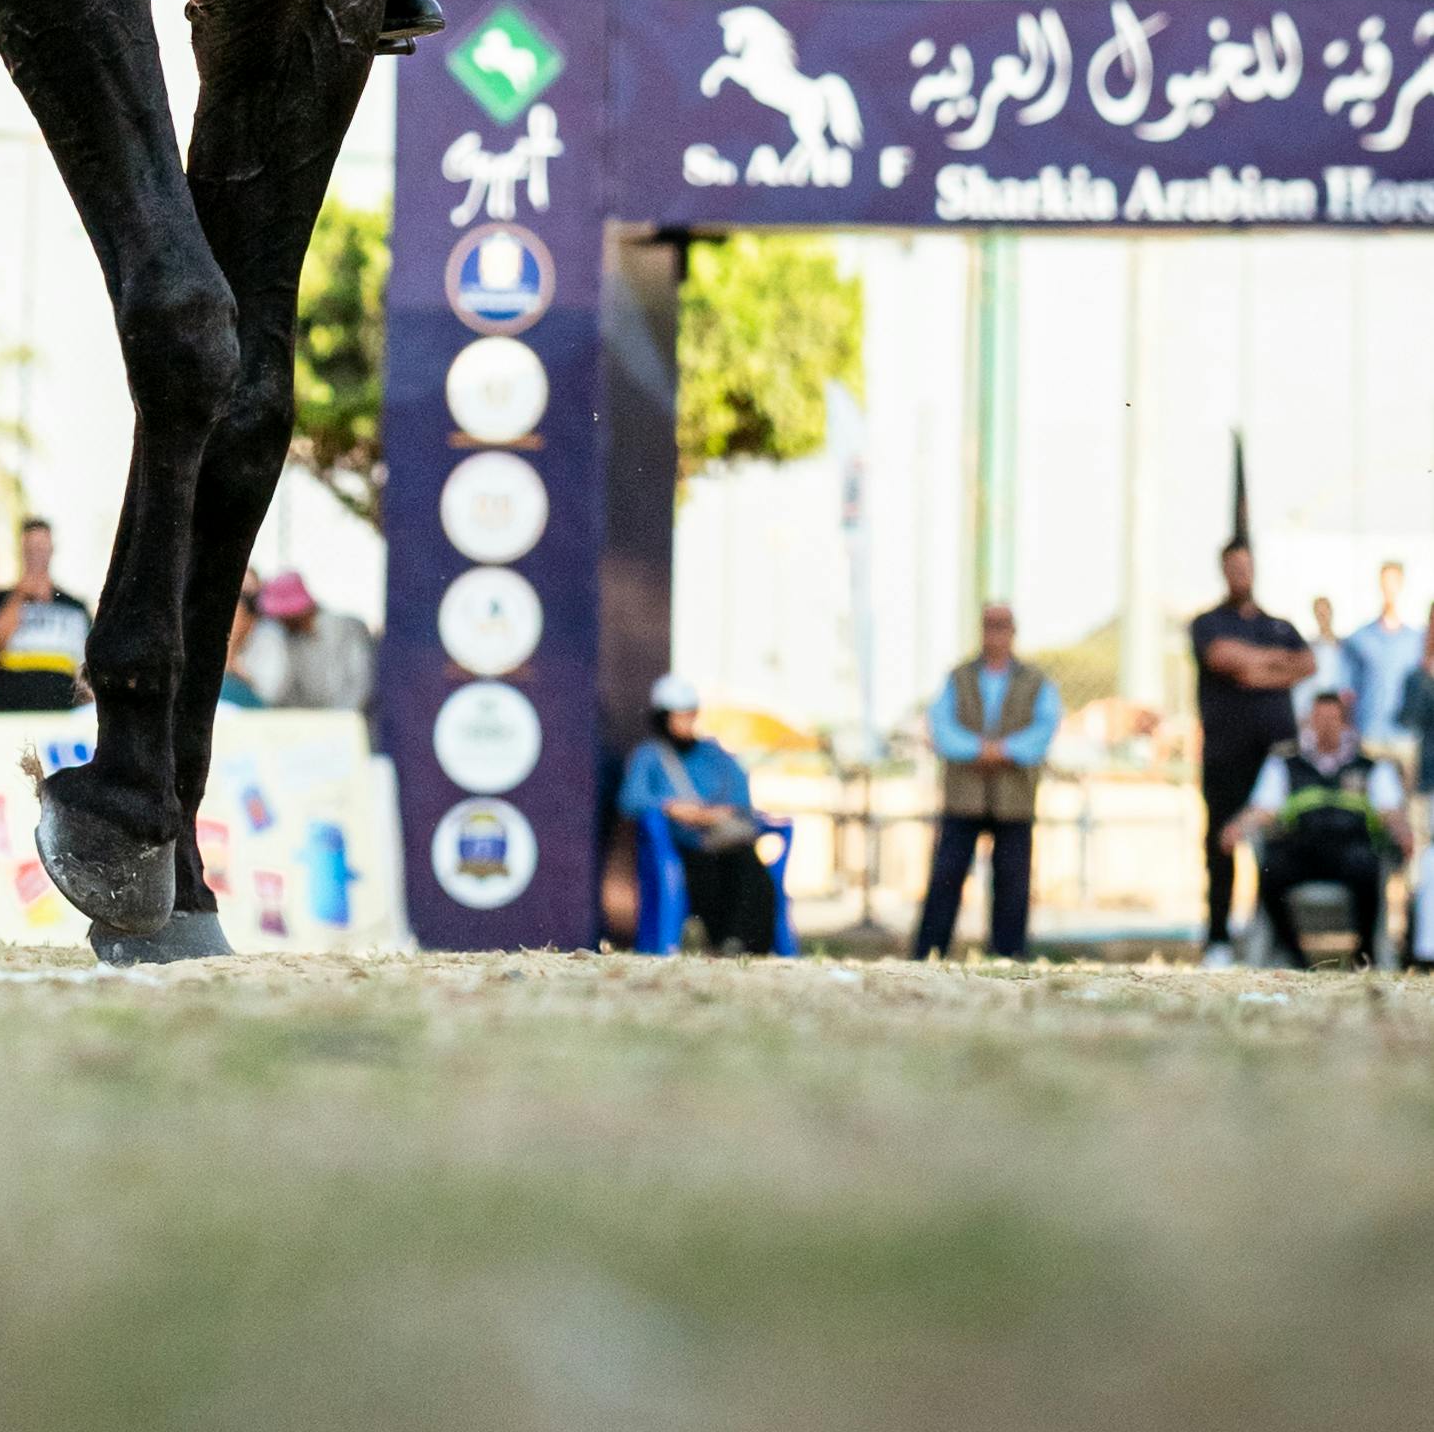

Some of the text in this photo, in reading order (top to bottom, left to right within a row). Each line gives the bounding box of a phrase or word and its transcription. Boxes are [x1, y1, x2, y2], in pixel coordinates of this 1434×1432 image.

[909, 8, 1073, 151] العربية
[935, 163, 1117, 221] Sharkia
[1123, 164, 1318, 222] Arabian
[1322, 165, 1434, 223] Hors
